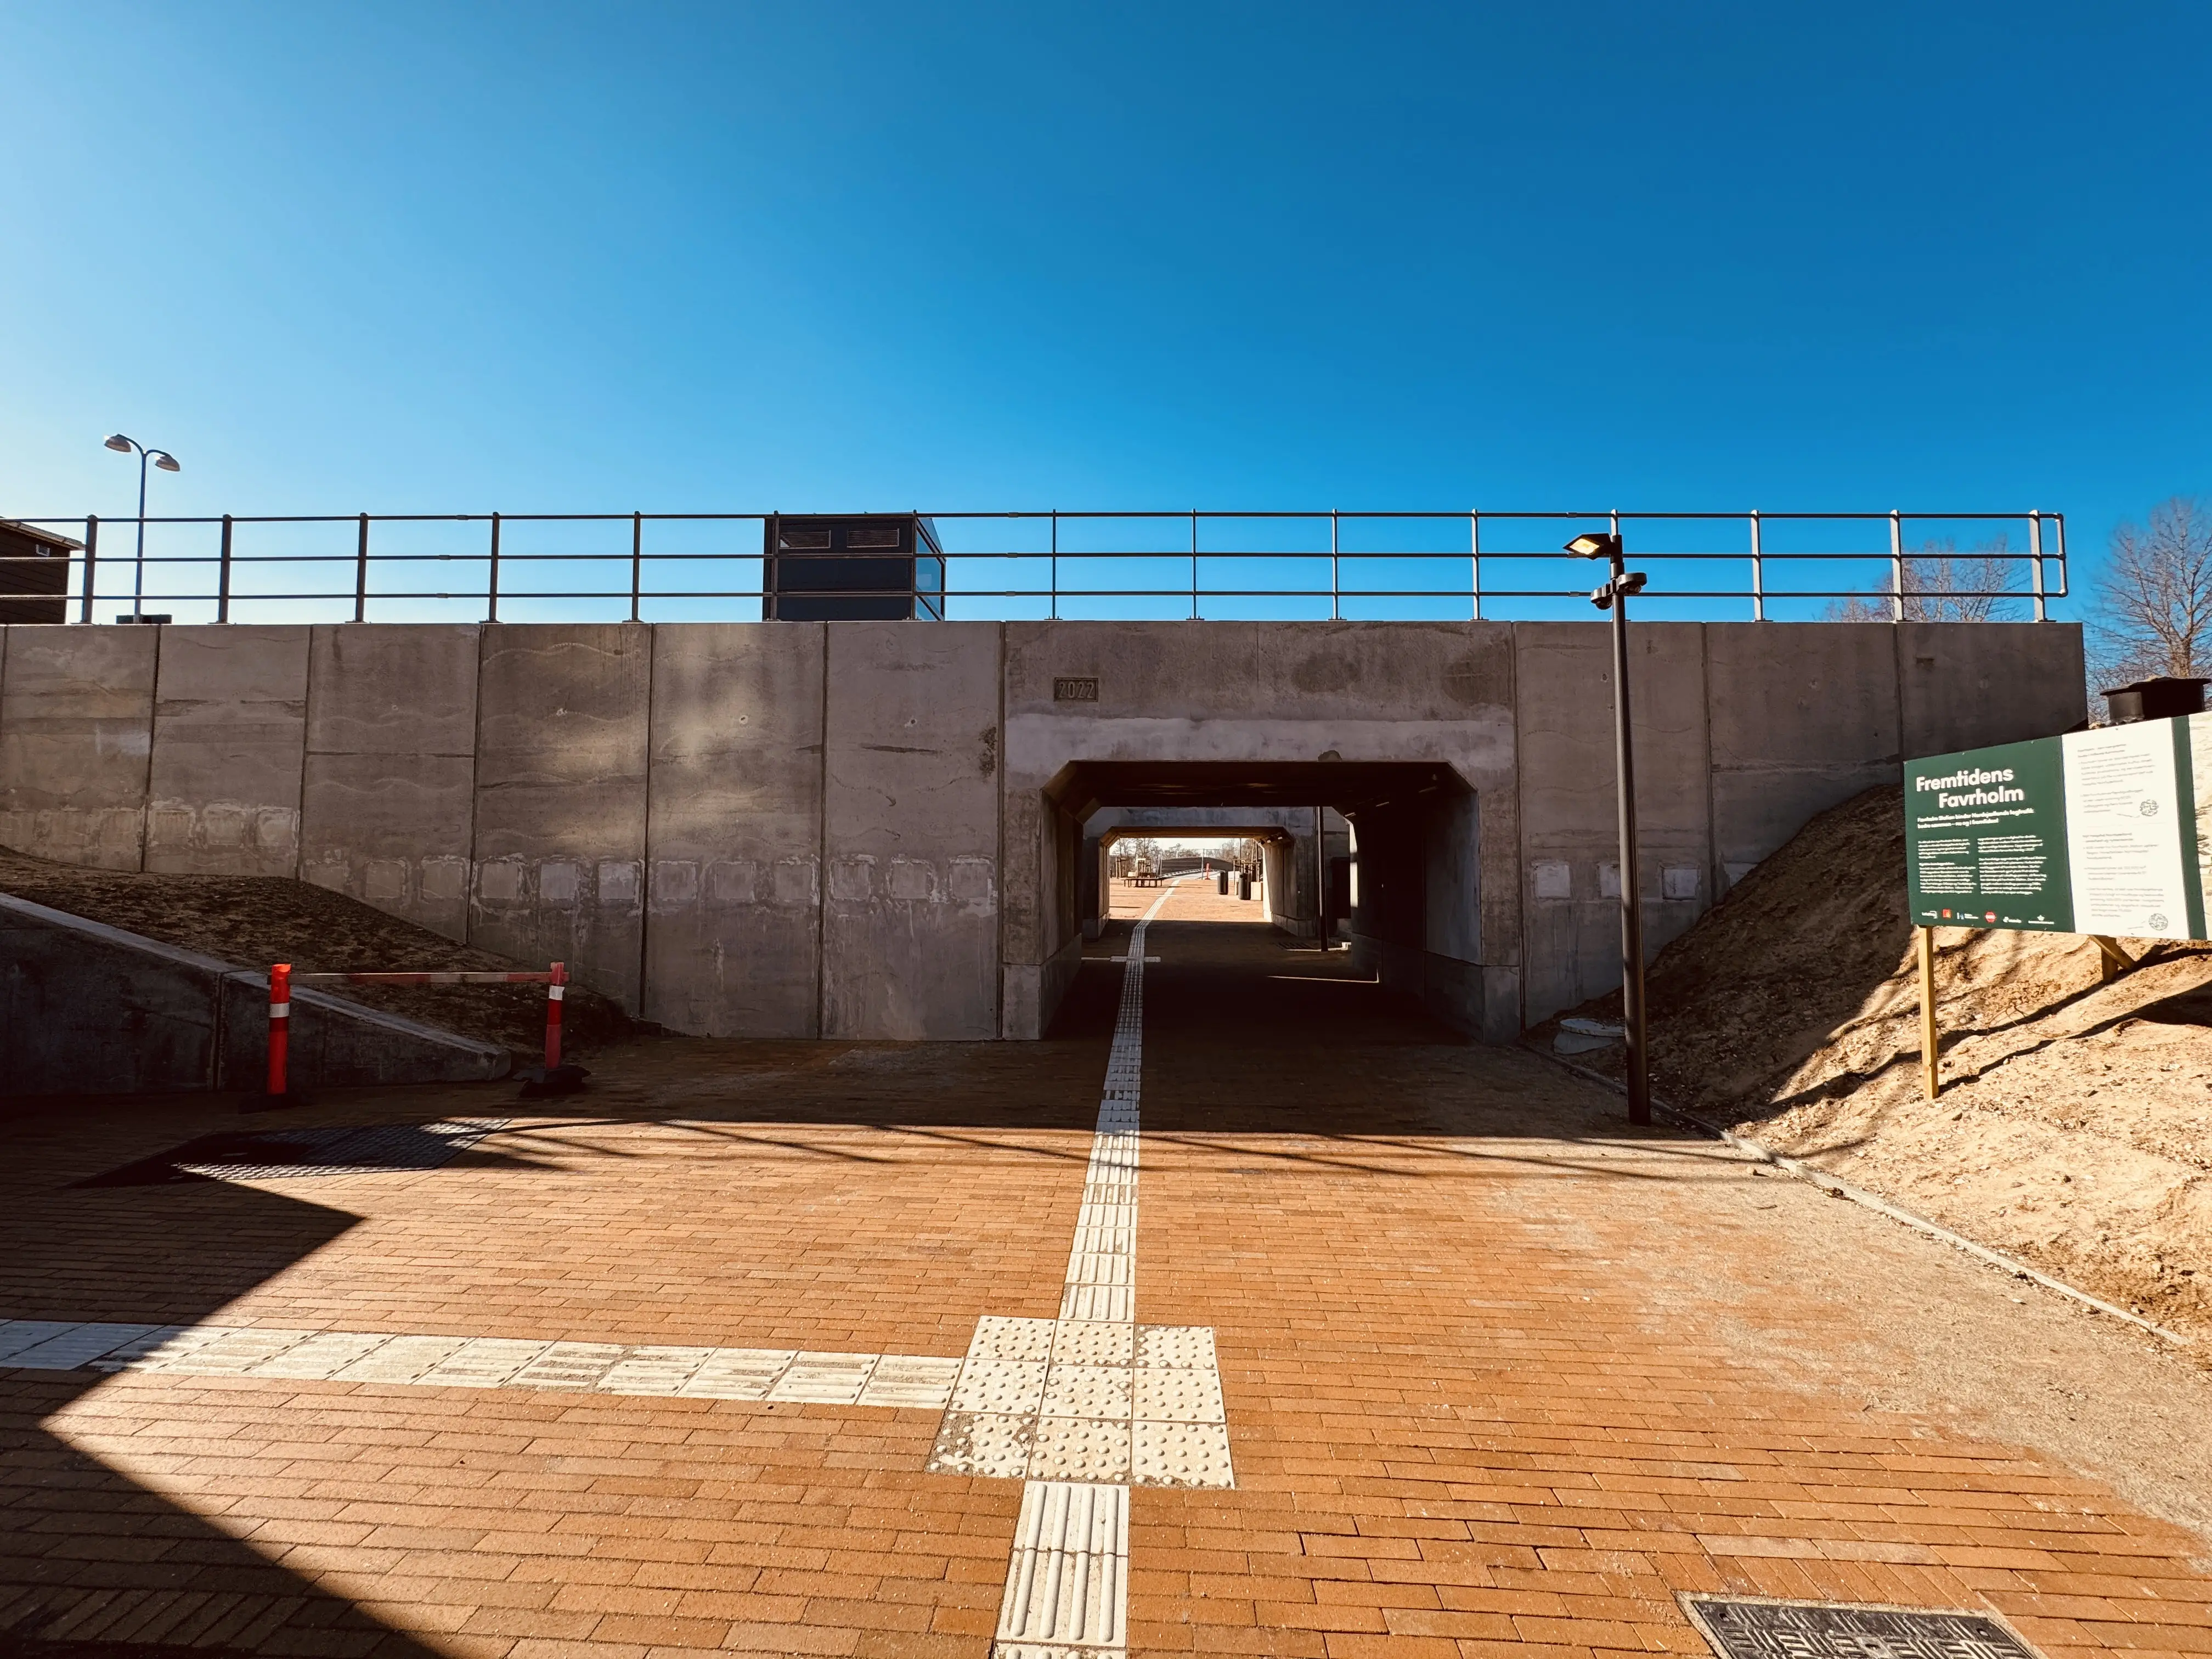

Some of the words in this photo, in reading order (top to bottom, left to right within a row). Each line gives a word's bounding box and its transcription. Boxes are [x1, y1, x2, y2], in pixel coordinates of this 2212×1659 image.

[1058, 681, 1094, 698] 2022
[1916, 768, 2014, 792] Fremtidens
[1939, 786, 2024, 808] Favrholm
